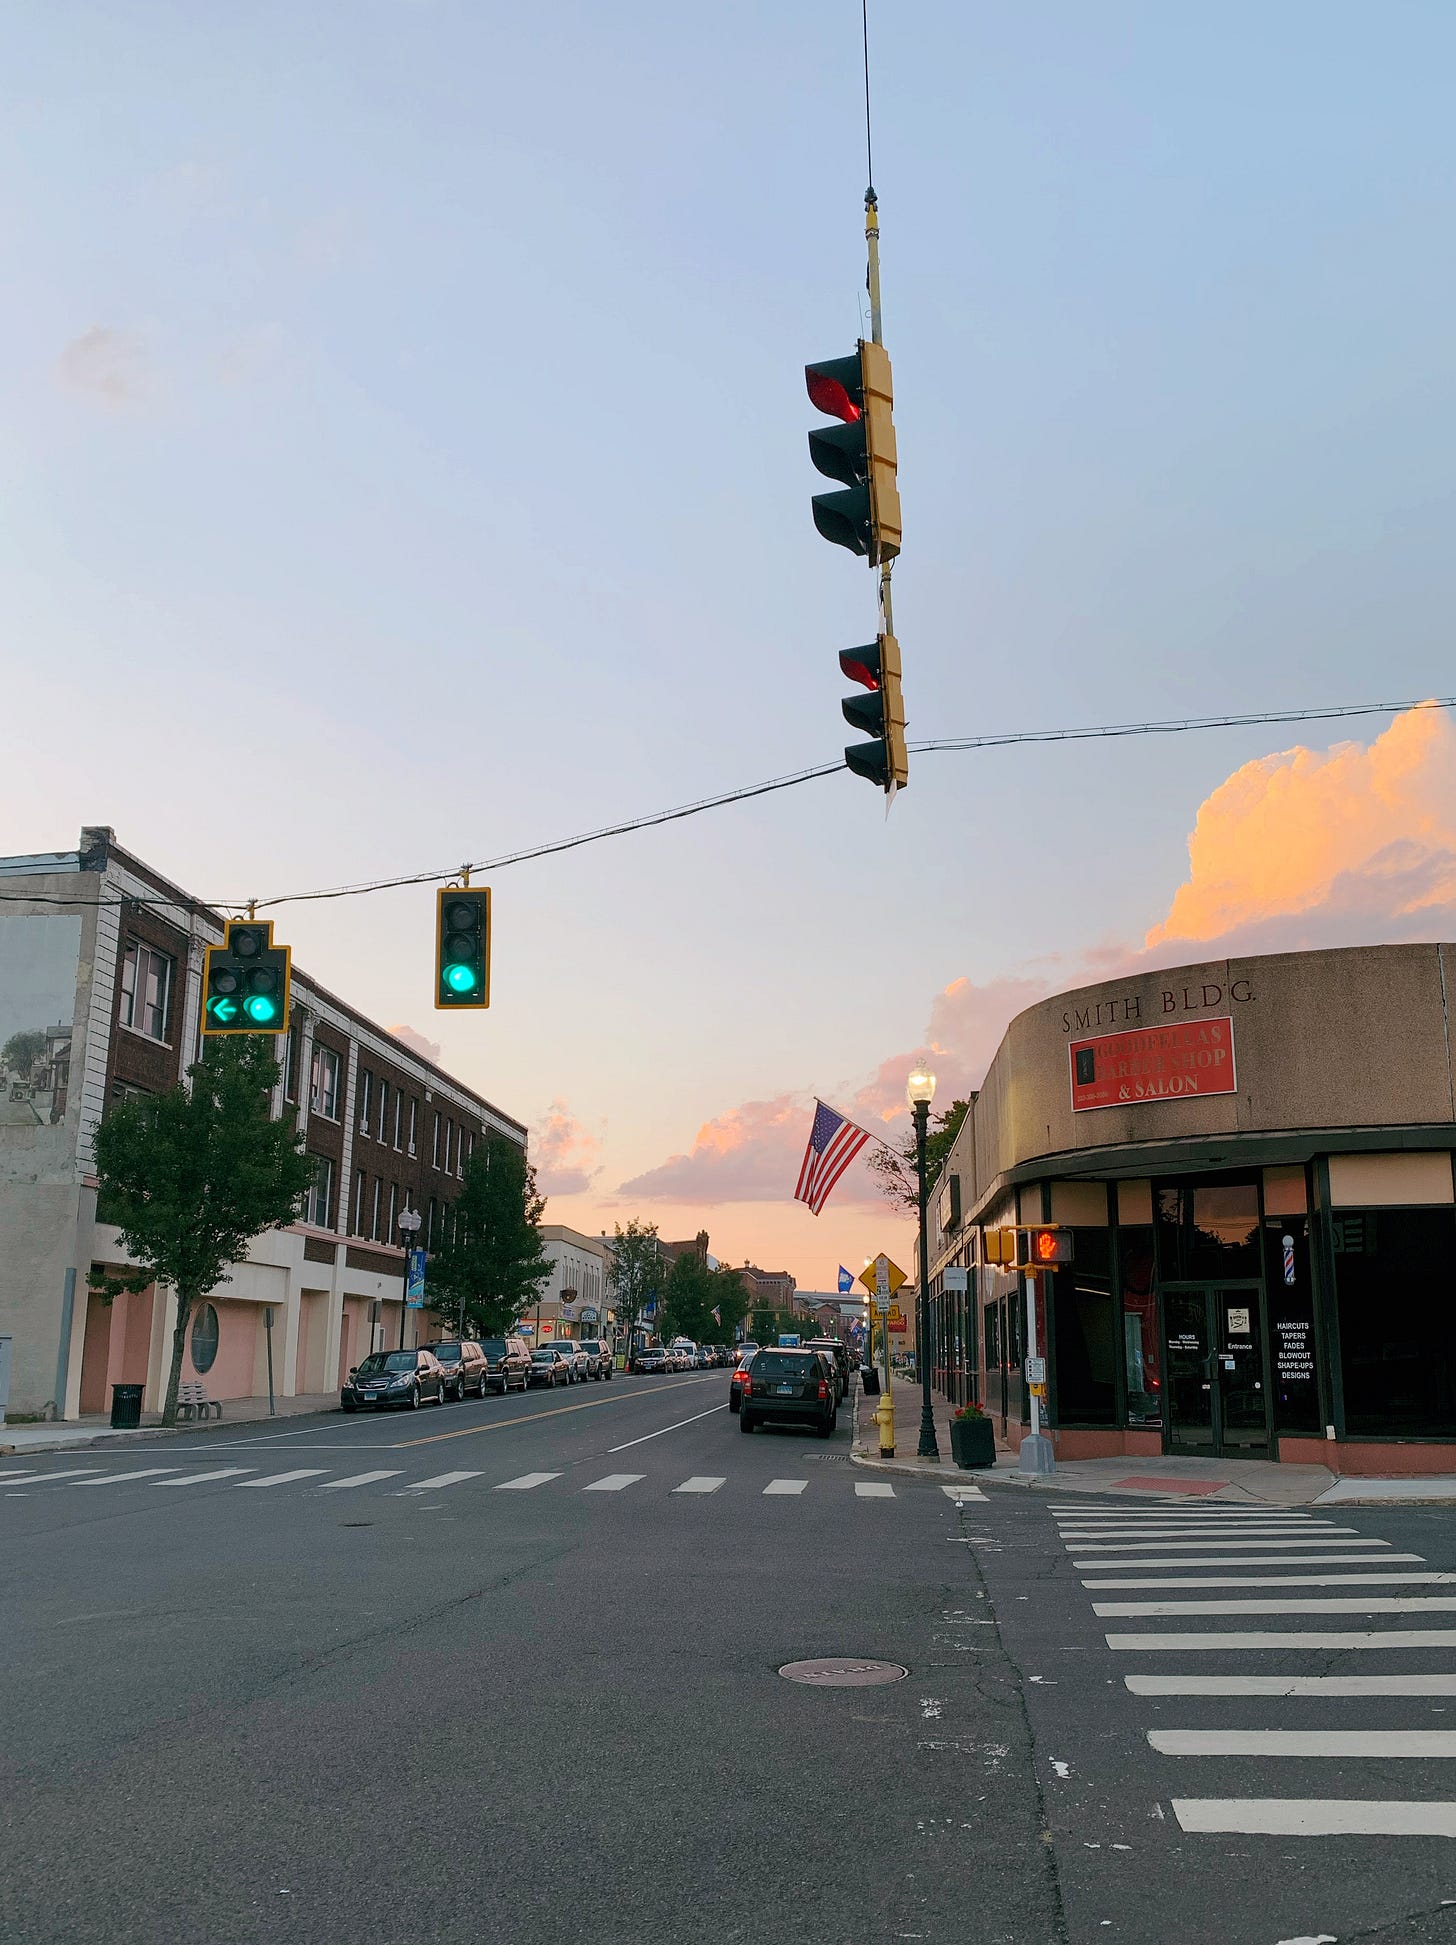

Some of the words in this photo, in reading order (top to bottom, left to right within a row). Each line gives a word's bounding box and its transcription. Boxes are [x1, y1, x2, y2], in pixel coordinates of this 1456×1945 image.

[1063, 997, 1141, 1032] SMITH
[1096, 1026, 1222, 1057] GOODFELLAS
[1119, 1084, 1131, 1099] &
[1135, 1074, 1198, 1098] SALON
